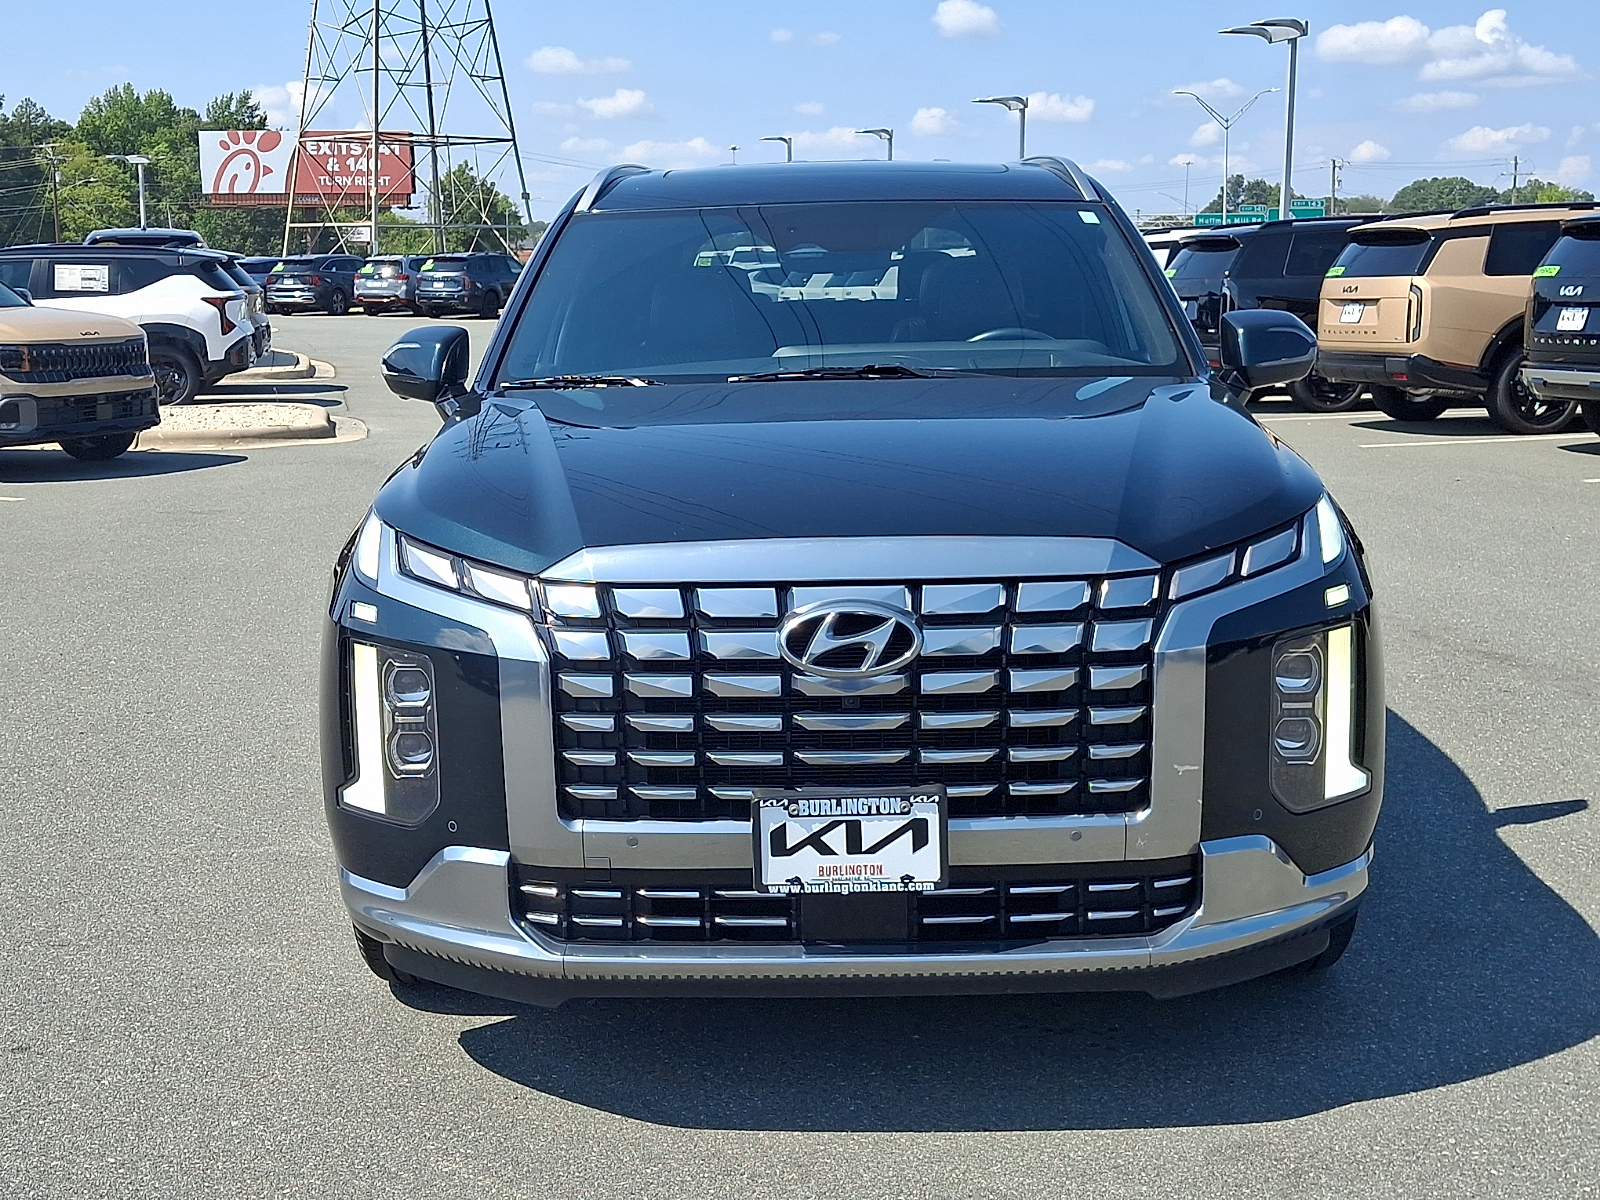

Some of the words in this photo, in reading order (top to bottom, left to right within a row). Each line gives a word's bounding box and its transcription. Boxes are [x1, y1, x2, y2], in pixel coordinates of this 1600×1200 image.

[306, 142, 362, 155] EXITS
[366, 141, 400, 155] 41
[327, 157, 340, 171] &
[319, 176, 351, 185] TURN
[1198, 217, 1231, 225] Huffmn
[1559, 285, 1583, 296] KIA
[760, 799, 788, 807] KIA
[910, 795, 939, 803] KIA
[798, 797, 901, 816] BURLINGTON
[770, 818, 929, 857] KIA
[818, 864, 883, 877] BURLINGTON
[768, 880, 935, 894] www.burlingtonkianc.com
